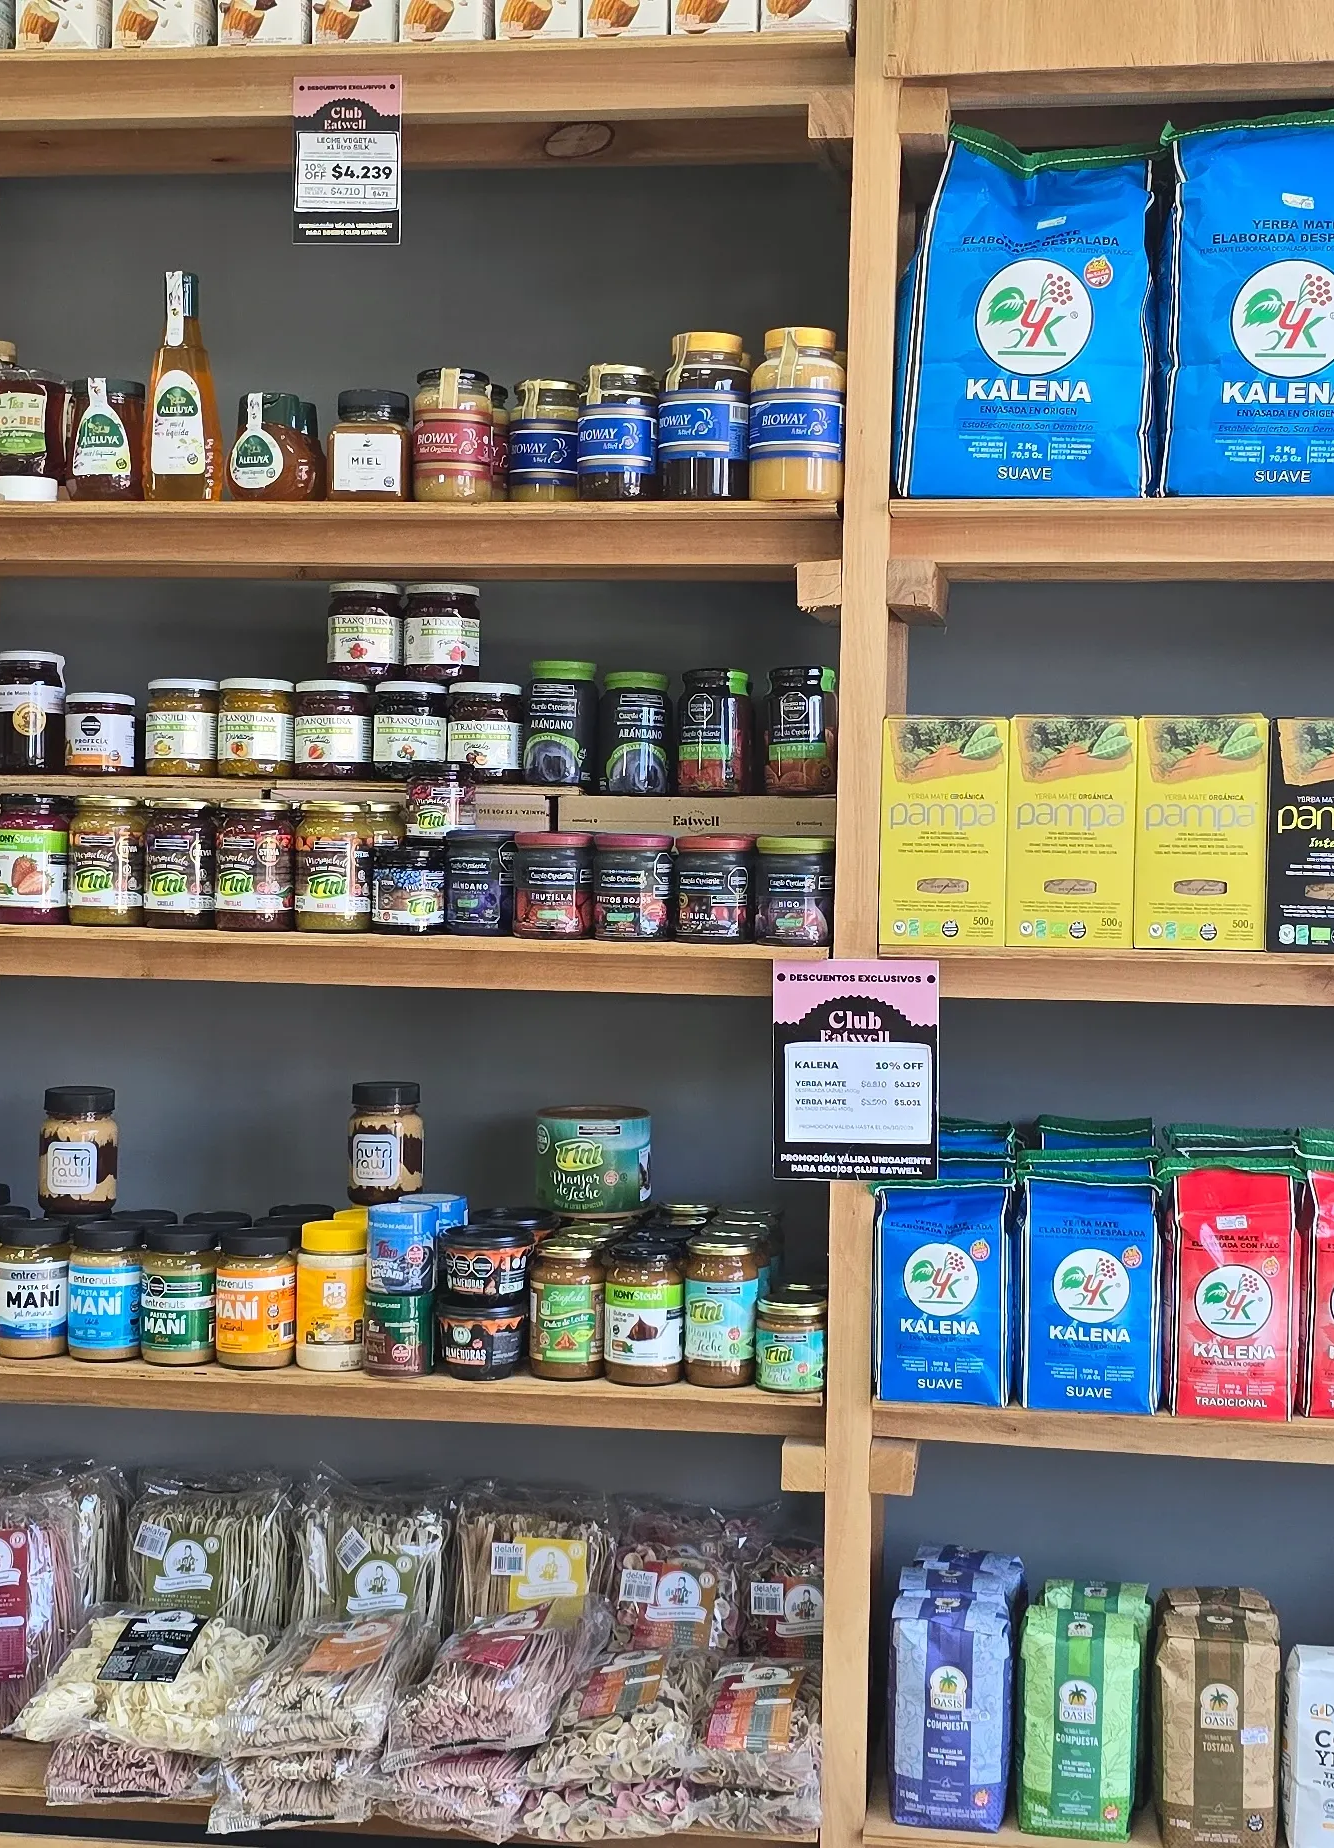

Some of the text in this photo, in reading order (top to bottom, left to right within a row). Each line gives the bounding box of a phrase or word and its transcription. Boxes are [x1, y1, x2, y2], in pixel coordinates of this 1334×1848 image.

[331, 107, 362, 119] Club
[324, 120, 366, 130] Eatwell
[305, 163, 392, 180] OFF $4.239
[1252, 219, 1299, 230] YERBA
[1212, 233, 1296, 245] ELABORADA
[966, 378, 1092, 403] KALENA
[160, 404, 194, 414] ALELUYA
[1237, 408, 1286, 419] ENVASADA
[1288, 409, 1300, 419] EN
[762, 413, 807, 426] BIOWAY
[417, 433, 458, 445] BIOWAY
[351, 456, 382, 466] MIEL
[997, 466, 1052, 481] SUAVE
[1254, 468, 1311, 484] SUAVE
[530, 717, 574, 731] ARÁNDANO
[672, 814, 720, 828] Eatwell
[1145, 802, 1256, 831] pampa
[219, 871, 253, 894] Trini
[789, 974, 921, 983] DESCUENTOS EXCLUSIVOS
[828, 1011, 881, 1029] Club
[795, 1061, 923, 1070] KALENA 10% OFF
[555, 1140, 603, 1165] Trini
[6, 1286, 60, 1309] MANÍ
[68, 1291, 122, 1316] MANÍ
[900, 1318, 980, 1335] KALENA
[1049, 1326, 1130, 1343] KALENA
[1193, 1343, 1276, 1360] KALENA
[917, 1378, 962, 1390] SUAVE
[1195, 1397, 1268, 1408] TRADICIONAL
[494, 1544, 524, 1554] delafer
[926, 1718, 969, 1732] COMPUESTA
[1204, 1714, 1235, 1727] OASIS
[1202, 1741, 1235, 1753] TOSTADA
